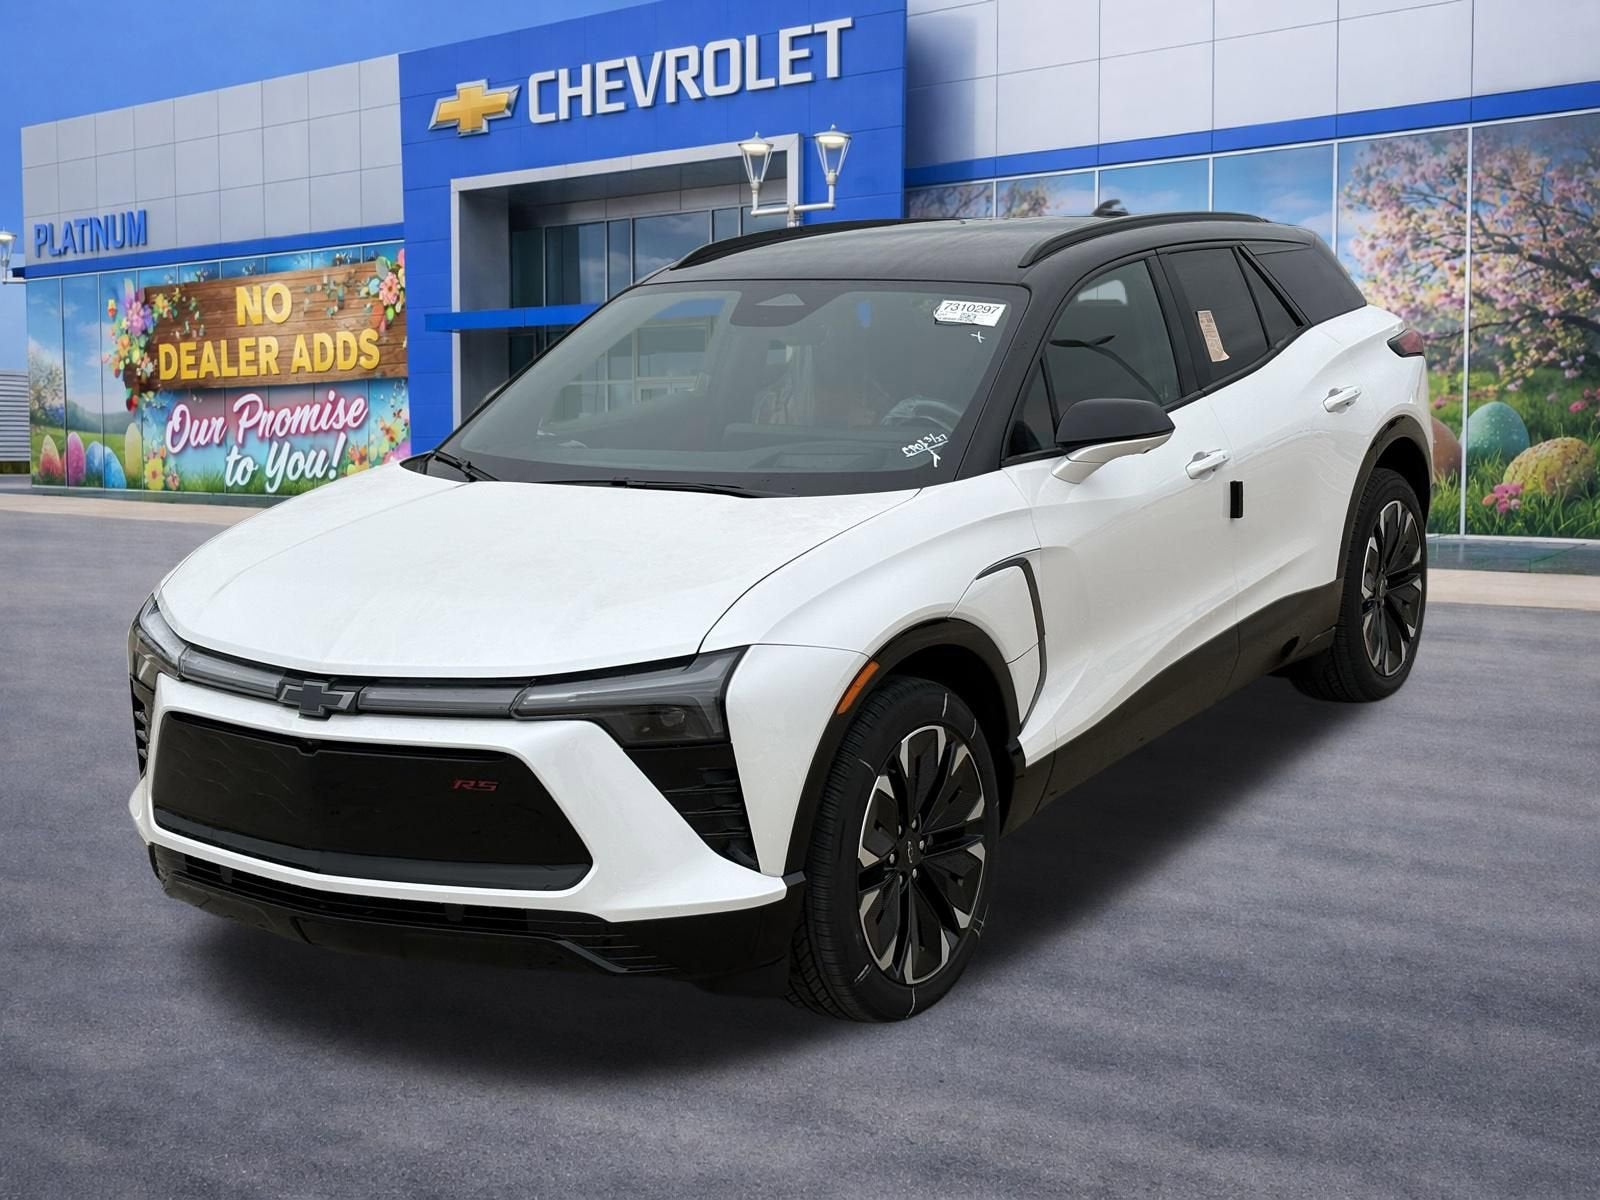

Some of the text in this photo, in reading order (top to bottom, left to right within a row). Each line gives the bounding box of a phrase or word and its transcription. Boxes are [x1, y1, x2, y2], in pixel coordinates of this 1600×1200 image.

[528, 17, 853, 124] CHEVROLET
[34, 209, 148, 257] PLATINUM
[235, 282, 292, 326] NO
[943, 302, 1001, 315] 7310297
[158, 328, 380, 380] DEALER ADDS
[165, 390, 368, 454] Our Promise
[224, 432, 347, 493] to You!
[452, 779, 498, 792] RS
